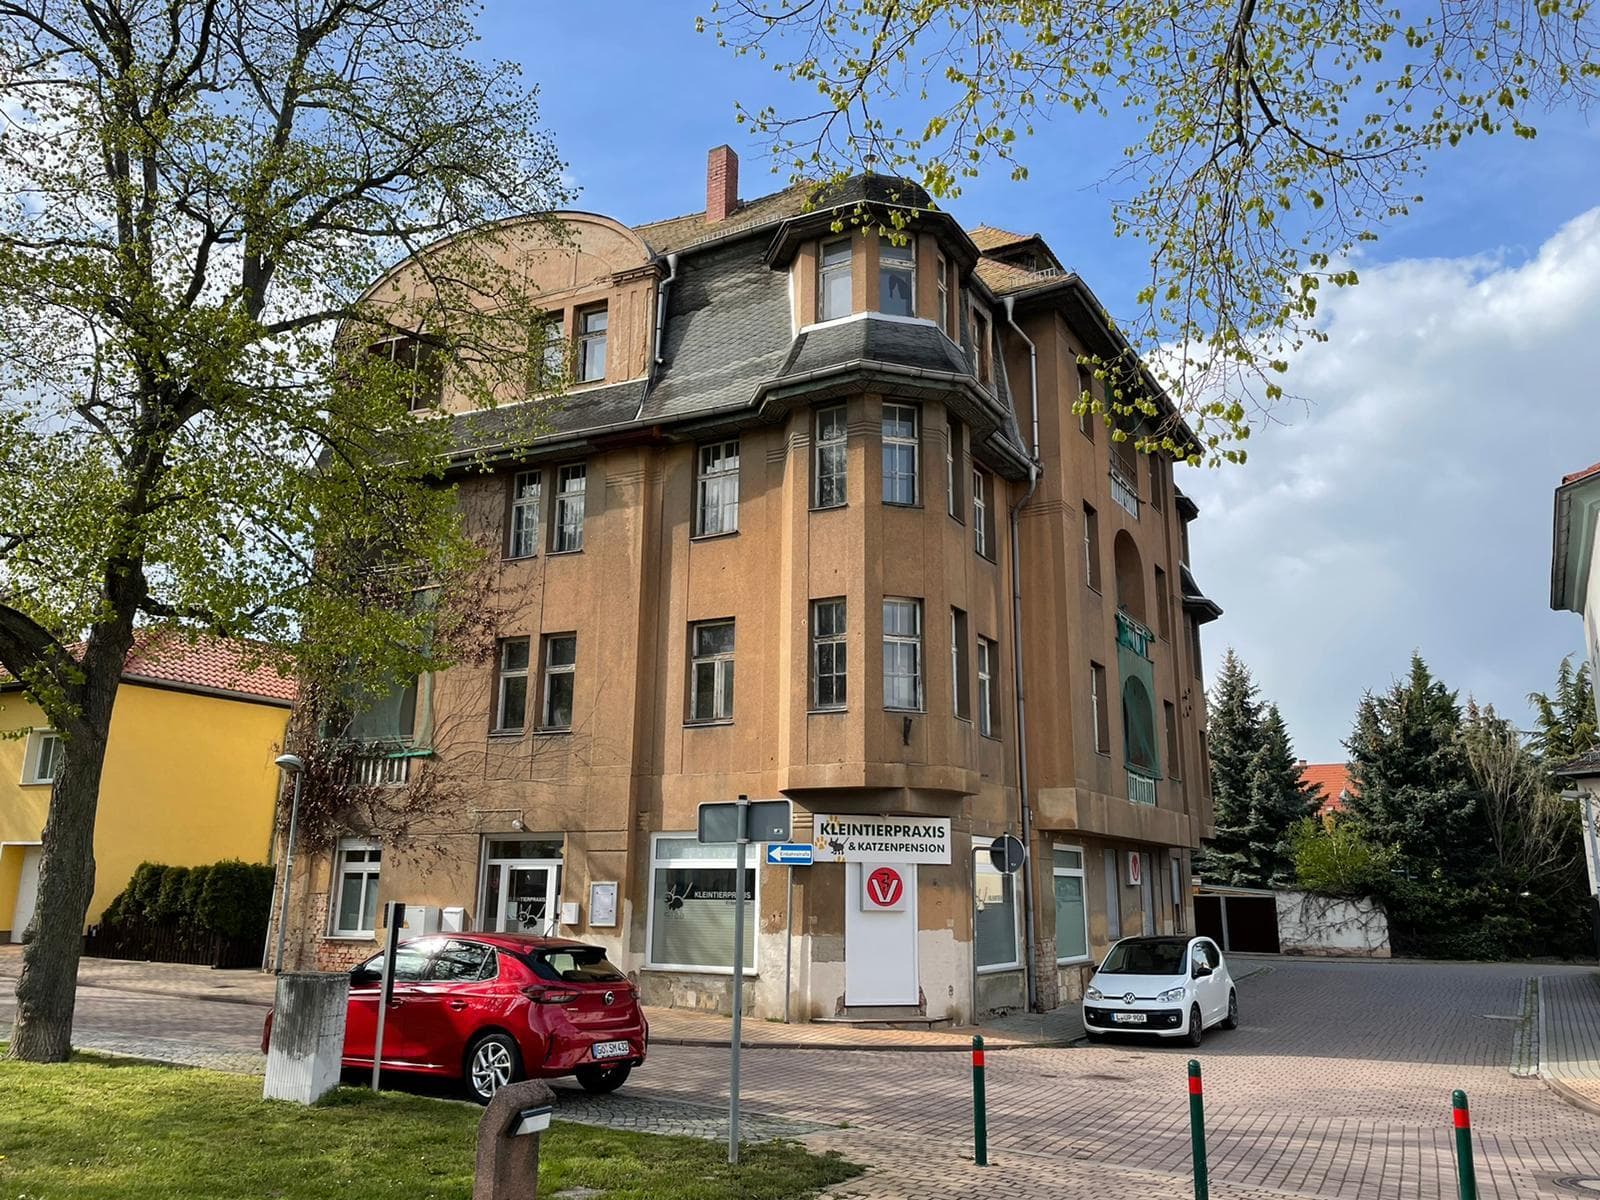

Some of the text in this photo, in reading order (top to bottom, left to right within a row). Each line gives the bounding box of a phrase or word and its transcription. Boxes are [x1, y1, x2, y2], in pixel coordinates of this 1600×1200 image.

[820, 822, 945, 838] KLEINTIERPRAXIS
[848, 842, 945, 853] & KATZENPENSION
